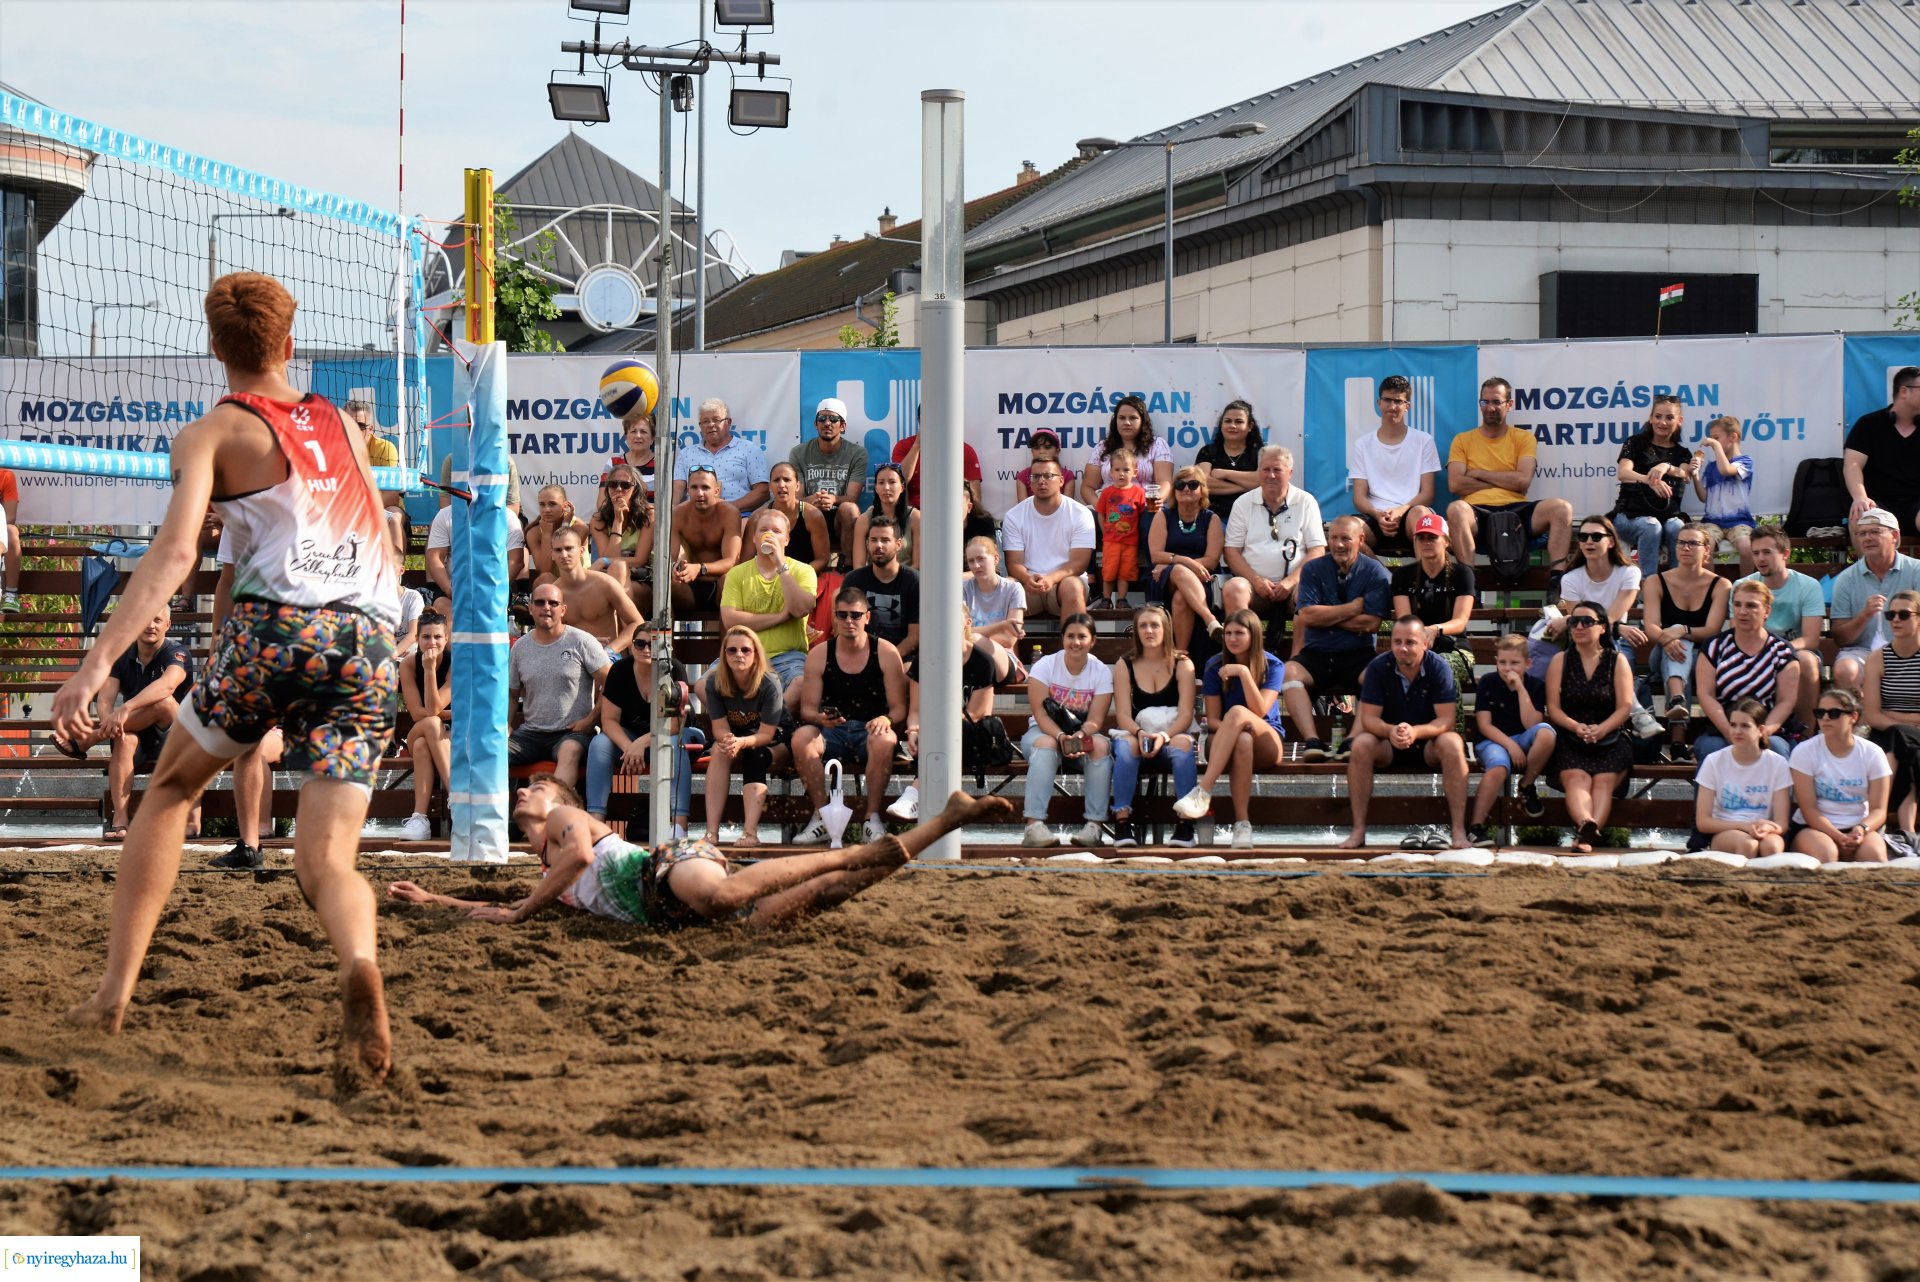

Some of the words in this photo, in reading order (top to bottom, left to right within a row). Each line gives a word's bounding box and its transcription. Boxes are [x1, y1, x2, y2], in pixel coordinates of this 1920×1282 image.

[934, 292, 946, 300] 36
[20, 396, 204, 422] MOZGÁSBAN
[508, 432, 632, 455] TARTJUK
[303, 440, 328, 473] 1
[300, 539, 346, 560] Beach
[289, 558, 362, 584] Volleyball
[1744, 785, 1769, 794] 2023
[1839, 778, 1864, 787] 2023
